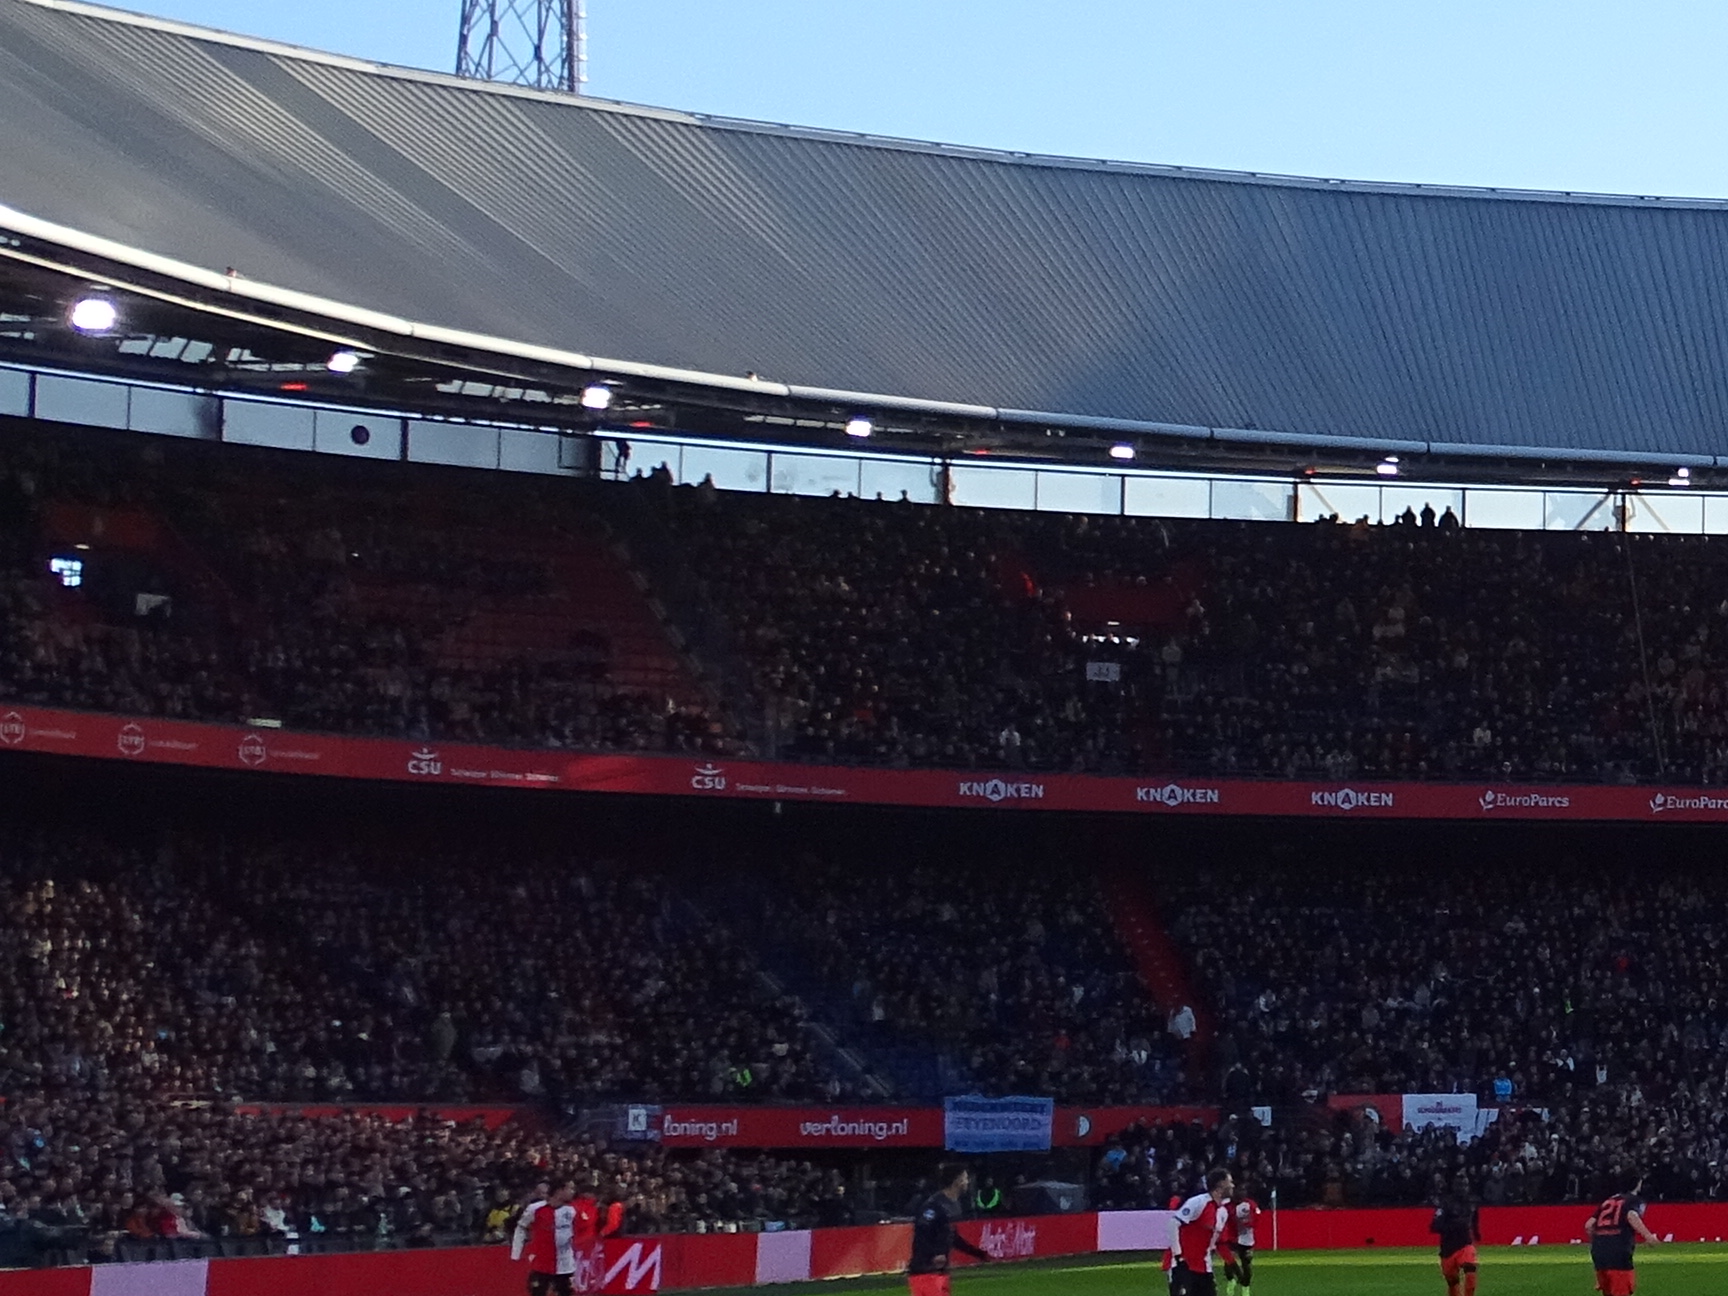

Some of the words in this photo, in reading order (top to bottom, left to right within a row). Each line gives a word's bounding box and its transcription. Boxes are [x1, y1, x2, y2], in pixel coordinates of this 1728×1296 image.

[407, 759, 442, 775] CSU
[691, 775, 726, 790] CSU
[959, 779, 1044, 802] KNAKEN
[1136, 784, 1219, 807] KNAKEN
[1311, 787, 1394, 810] KNAKEN
[1496, 793, 1570, 809] EuroParcs
[799, 1114, 908, 1140] verloning.nl
[1597, 1197, 1626, 1227] 21
